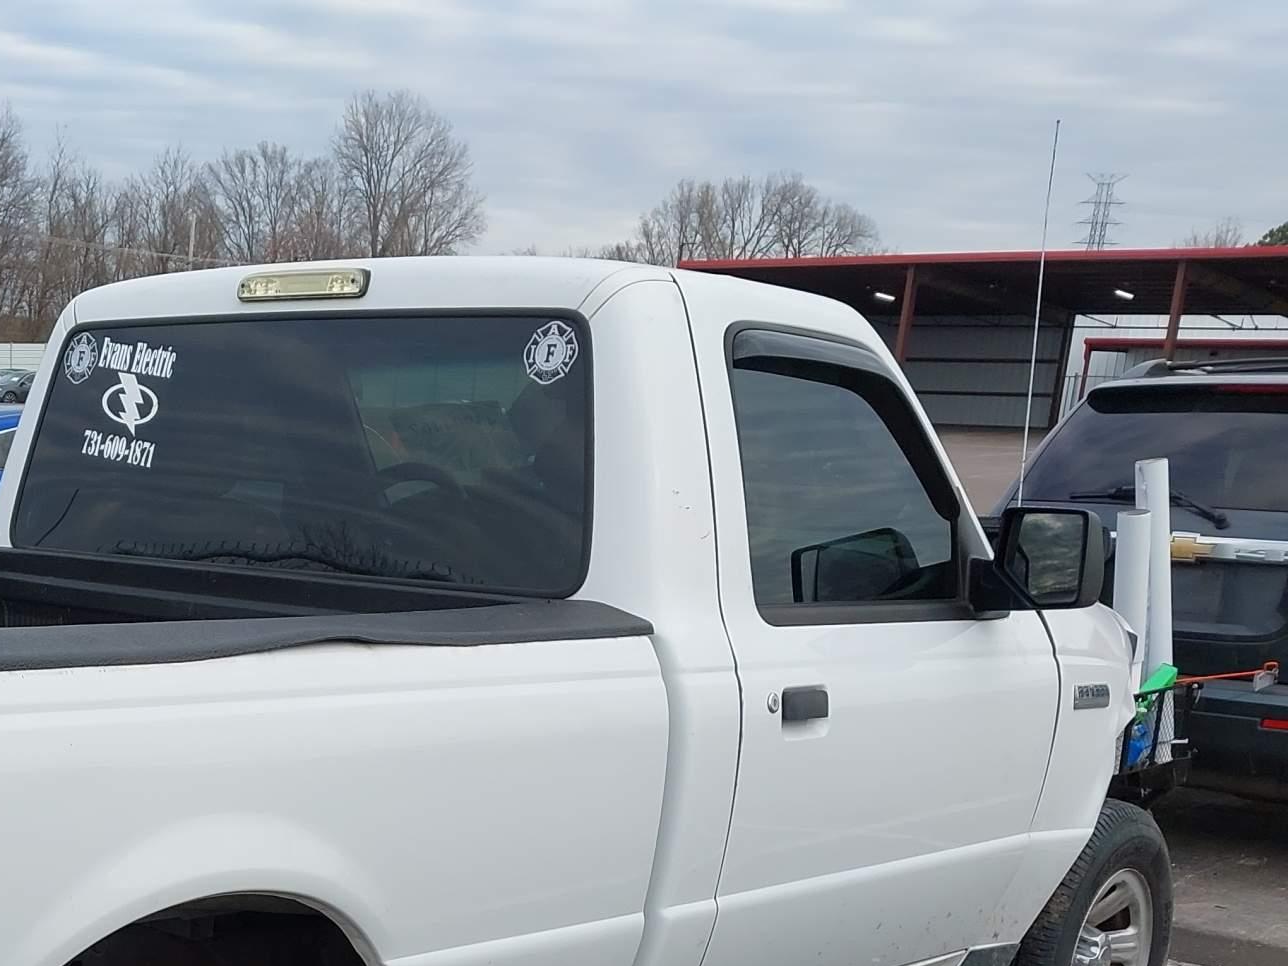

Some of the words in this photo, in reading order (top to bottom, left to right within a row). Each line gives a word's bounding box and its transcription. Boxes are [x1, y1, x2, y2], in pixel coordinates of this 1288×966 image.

[546, 324, 560, 336] A
[77, 350, 86, 367] F
[98, 337, 133, 371] Evans
[131, 342, 176, 378] Electric
[528, 345, 536, 363] I
[544, 344, 557, 362] F
[564, 344, 575, 362] F
[81, 429, 155, 468] 731-609-1871
